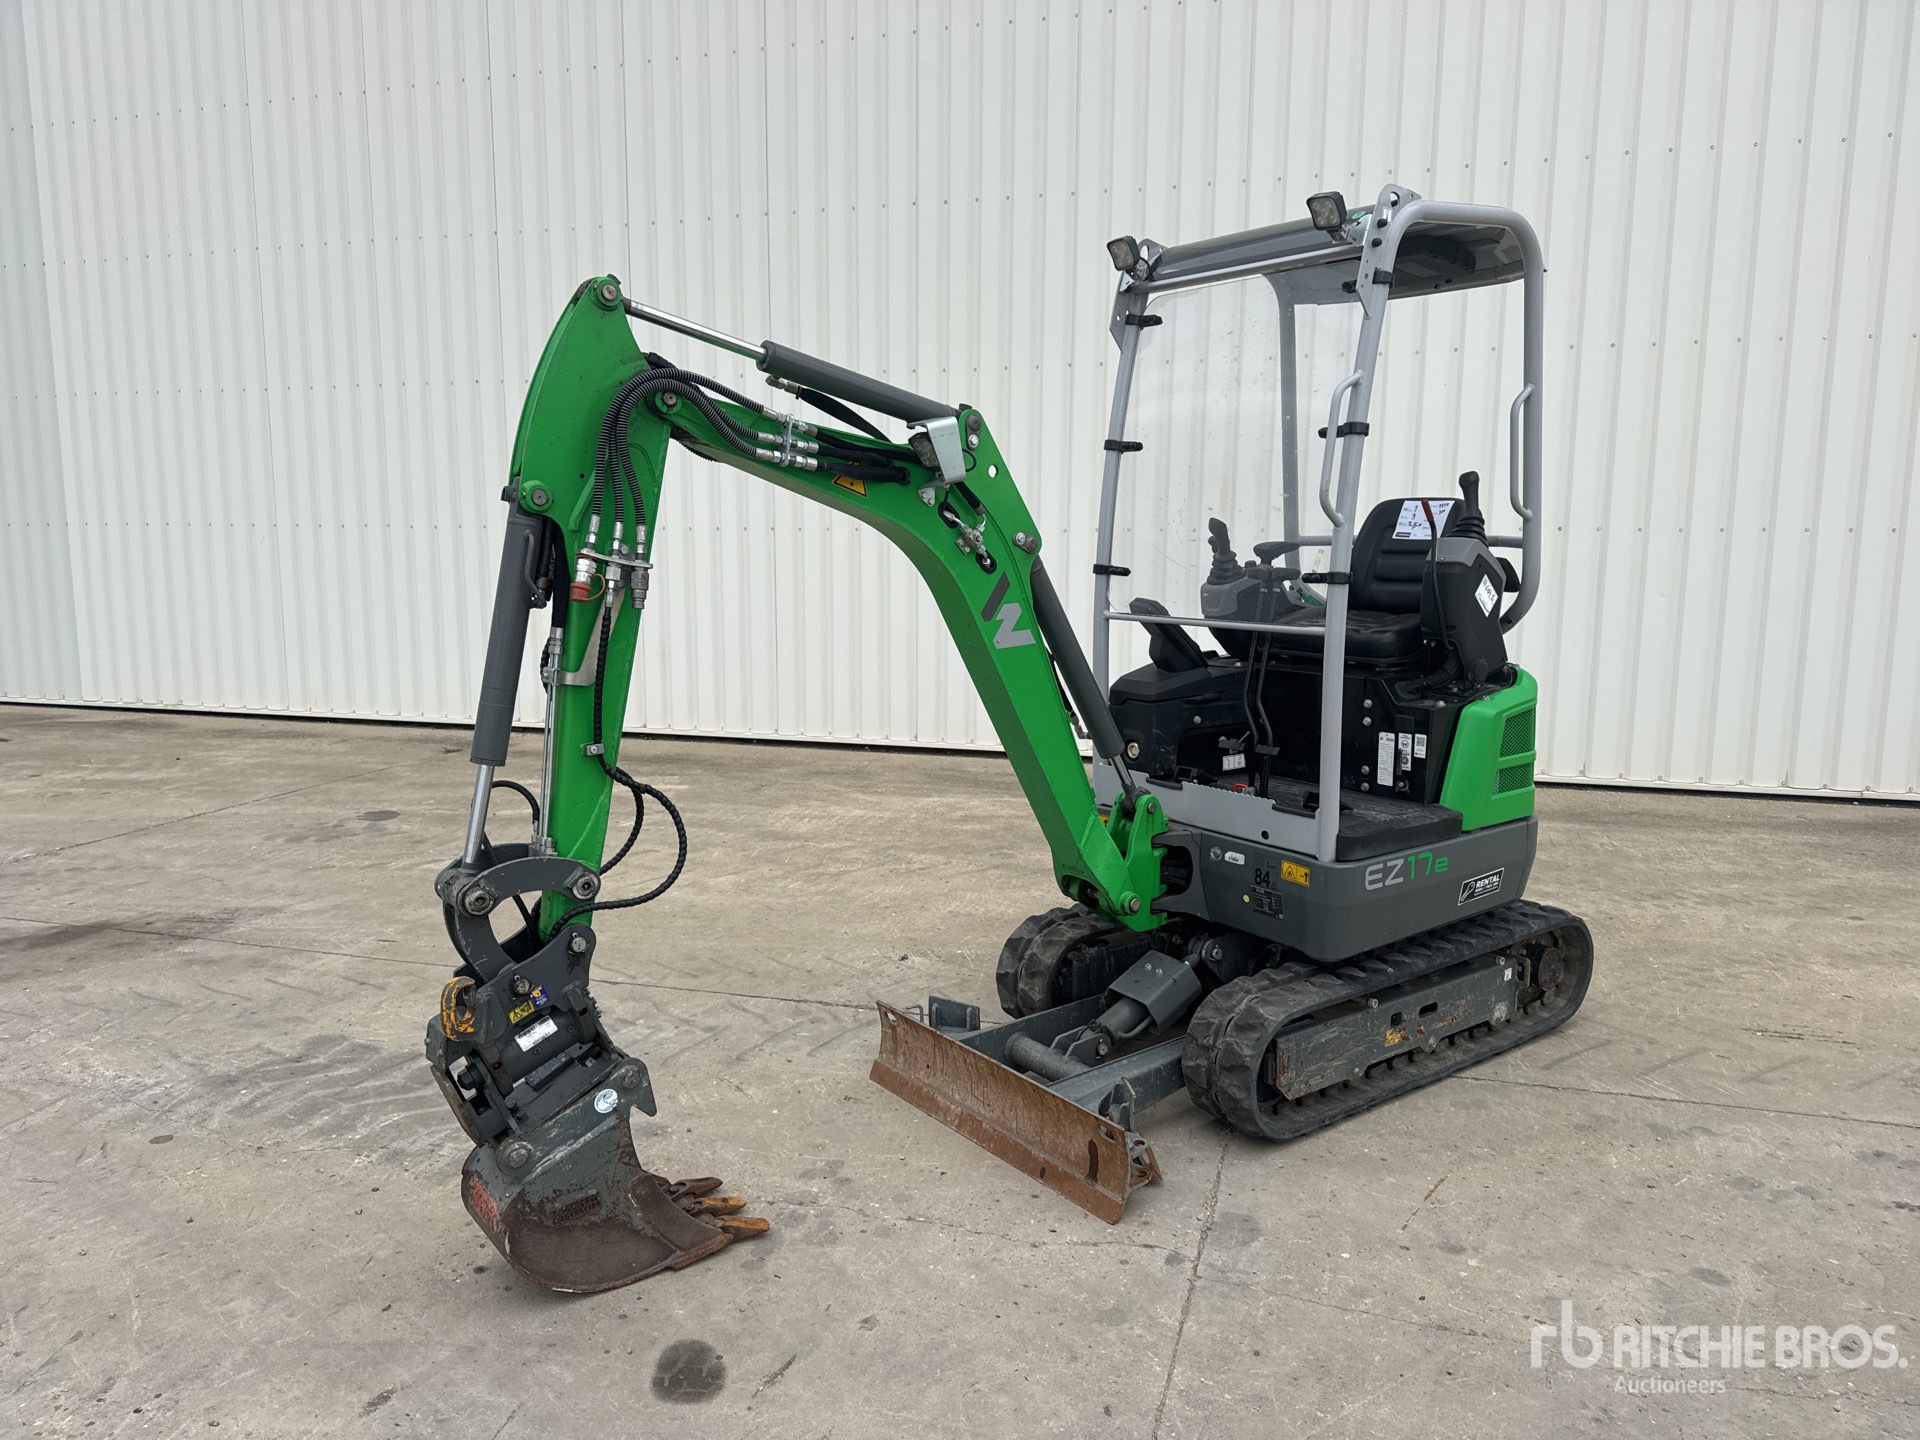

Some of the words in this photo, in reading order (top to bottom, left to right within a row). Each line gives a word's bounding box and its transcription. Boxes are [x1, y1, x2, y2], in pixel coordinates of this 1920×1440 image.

[1254, 867, 1270, 887] 84
[1365, 851, 1449, 891] EZ17e
[1476, 874, 1500, 889] RENTAL
